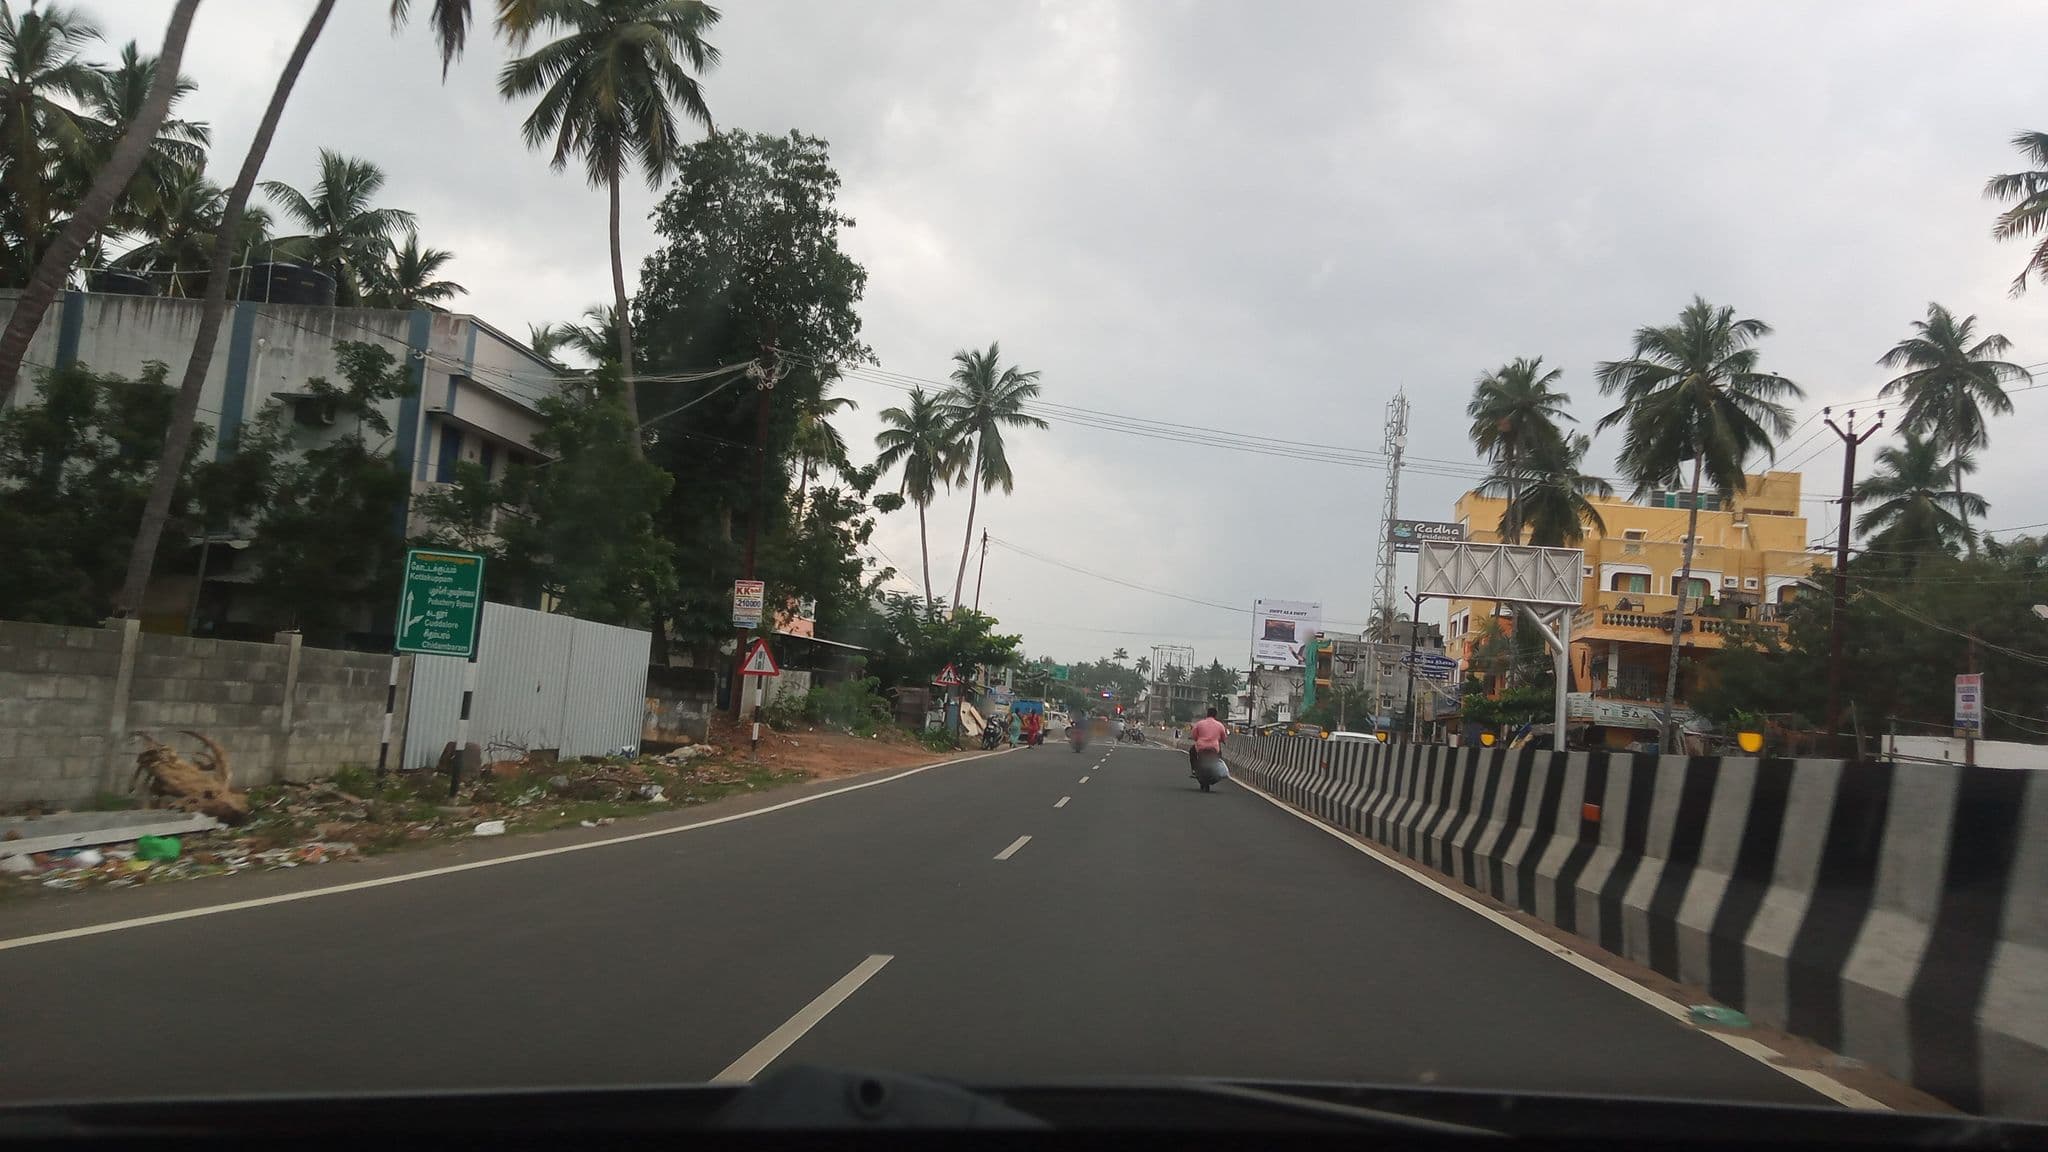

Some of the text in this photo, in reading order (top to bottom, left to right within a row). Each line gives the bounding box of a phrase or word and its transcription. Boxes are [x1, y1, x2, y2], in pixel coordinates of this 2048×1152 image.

[1414, 523, 1459, 535] Radha
[424, 619, 459, 629] Cuddalore
[421, 641, 468, 652] Chidambaram
